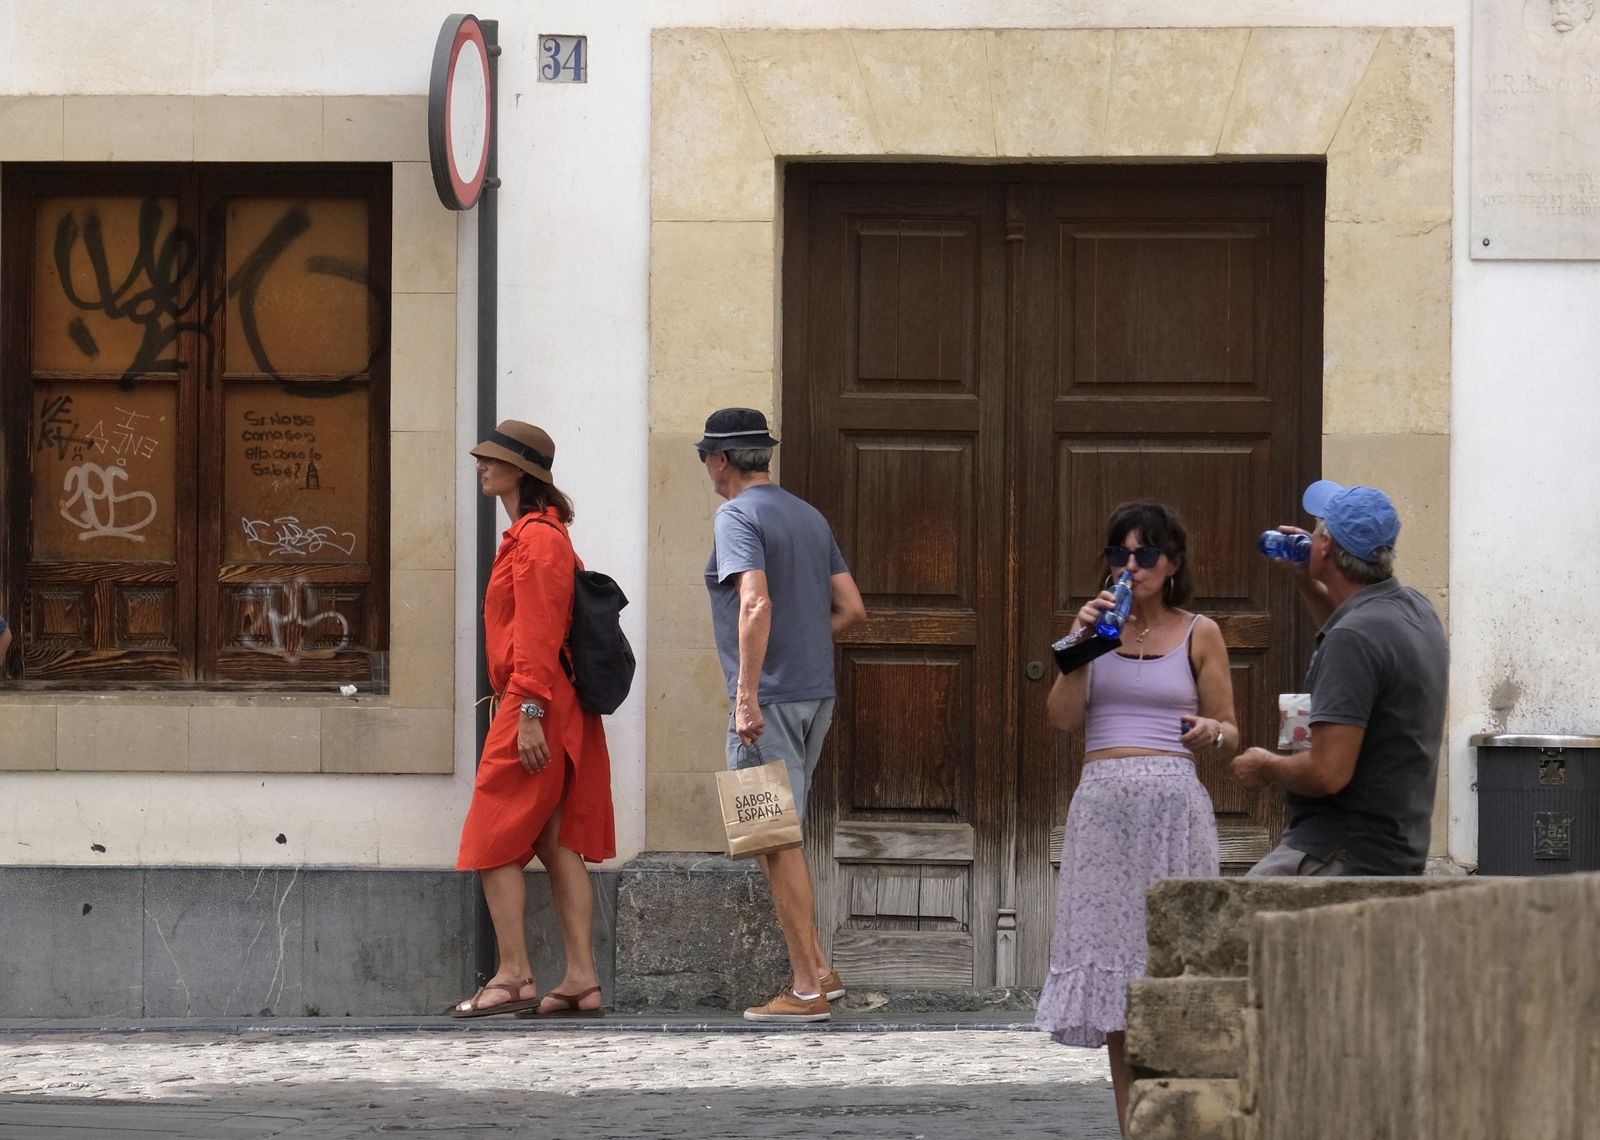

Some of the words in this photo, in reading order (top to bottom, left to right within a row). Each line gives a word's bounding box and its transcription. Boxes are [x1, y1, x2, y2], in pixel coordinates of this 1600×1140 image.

[542, 38, 584, 81] 34
[735, 791, 772, 809] SABOR
[737, 803, 783, 823] ESPAÑA
